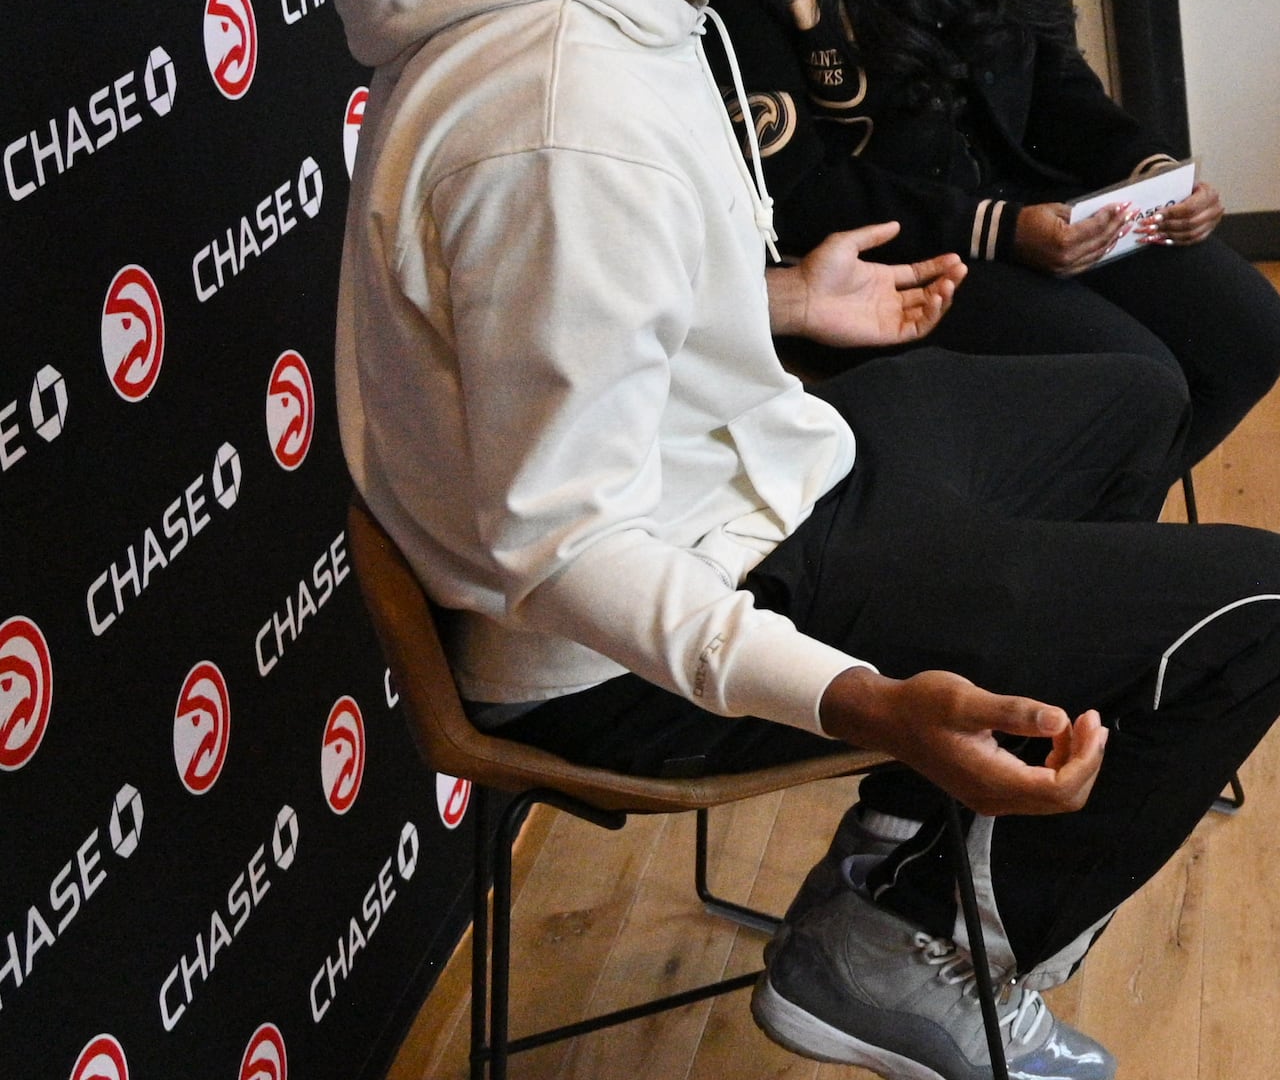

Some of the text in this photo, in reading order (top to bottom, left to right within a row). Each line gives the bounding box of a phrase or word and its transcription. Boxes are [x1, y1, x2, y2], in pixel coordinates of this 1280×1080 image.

[4, 71, 143, 201] CHASE
[193, 180, 298, 302] CHASE
[87, 474, 211, 636] CHASE
[256, 531, 351, 677] CHASE
[0, 828, 108, 1010] HASE
[160, 844, 271, 1032] CHASE
[311, 858, 397, 1023] CHASE
